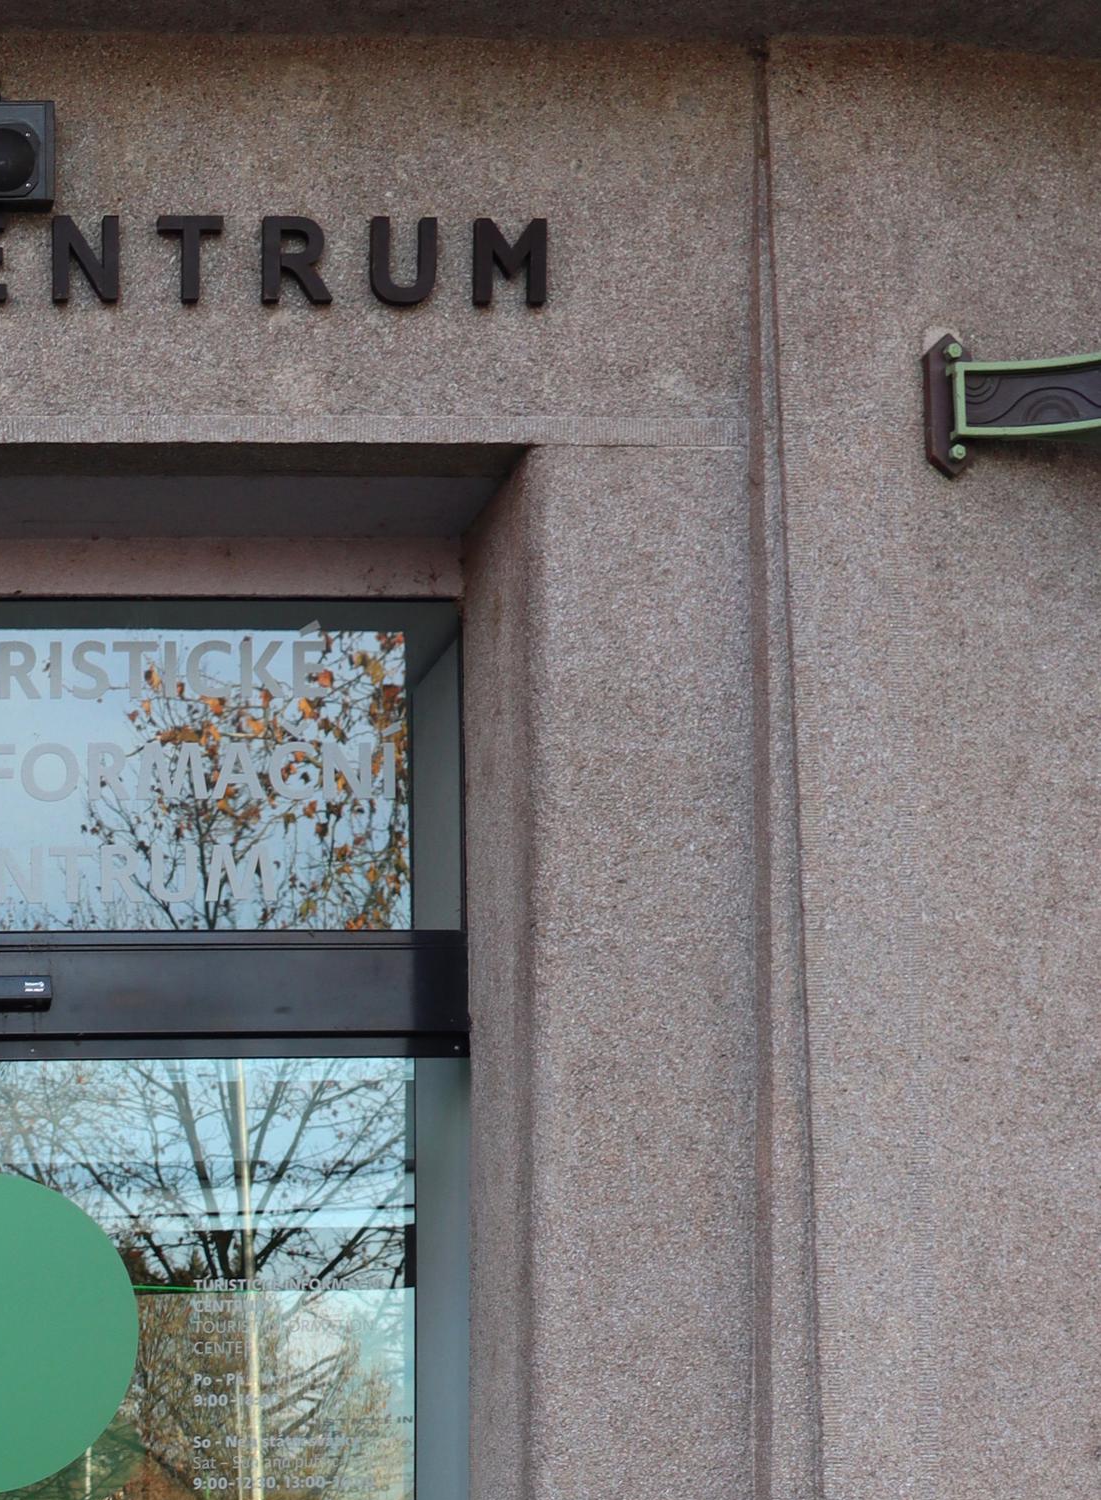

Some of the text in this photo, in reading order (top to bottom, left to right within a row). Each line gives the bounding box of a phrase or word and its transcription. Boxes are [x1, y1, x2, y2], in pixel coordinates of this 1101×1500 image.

[193, 1299, 264, 1313] CENTR
[193, 1320, 257, 1334] TOURIS
[193, 1372, 212, 1387] Po
[193, 1435, 212, 1449] So
[193, 1456, 217, 1470] Sat
[265, 1455, 290, 1469] and
